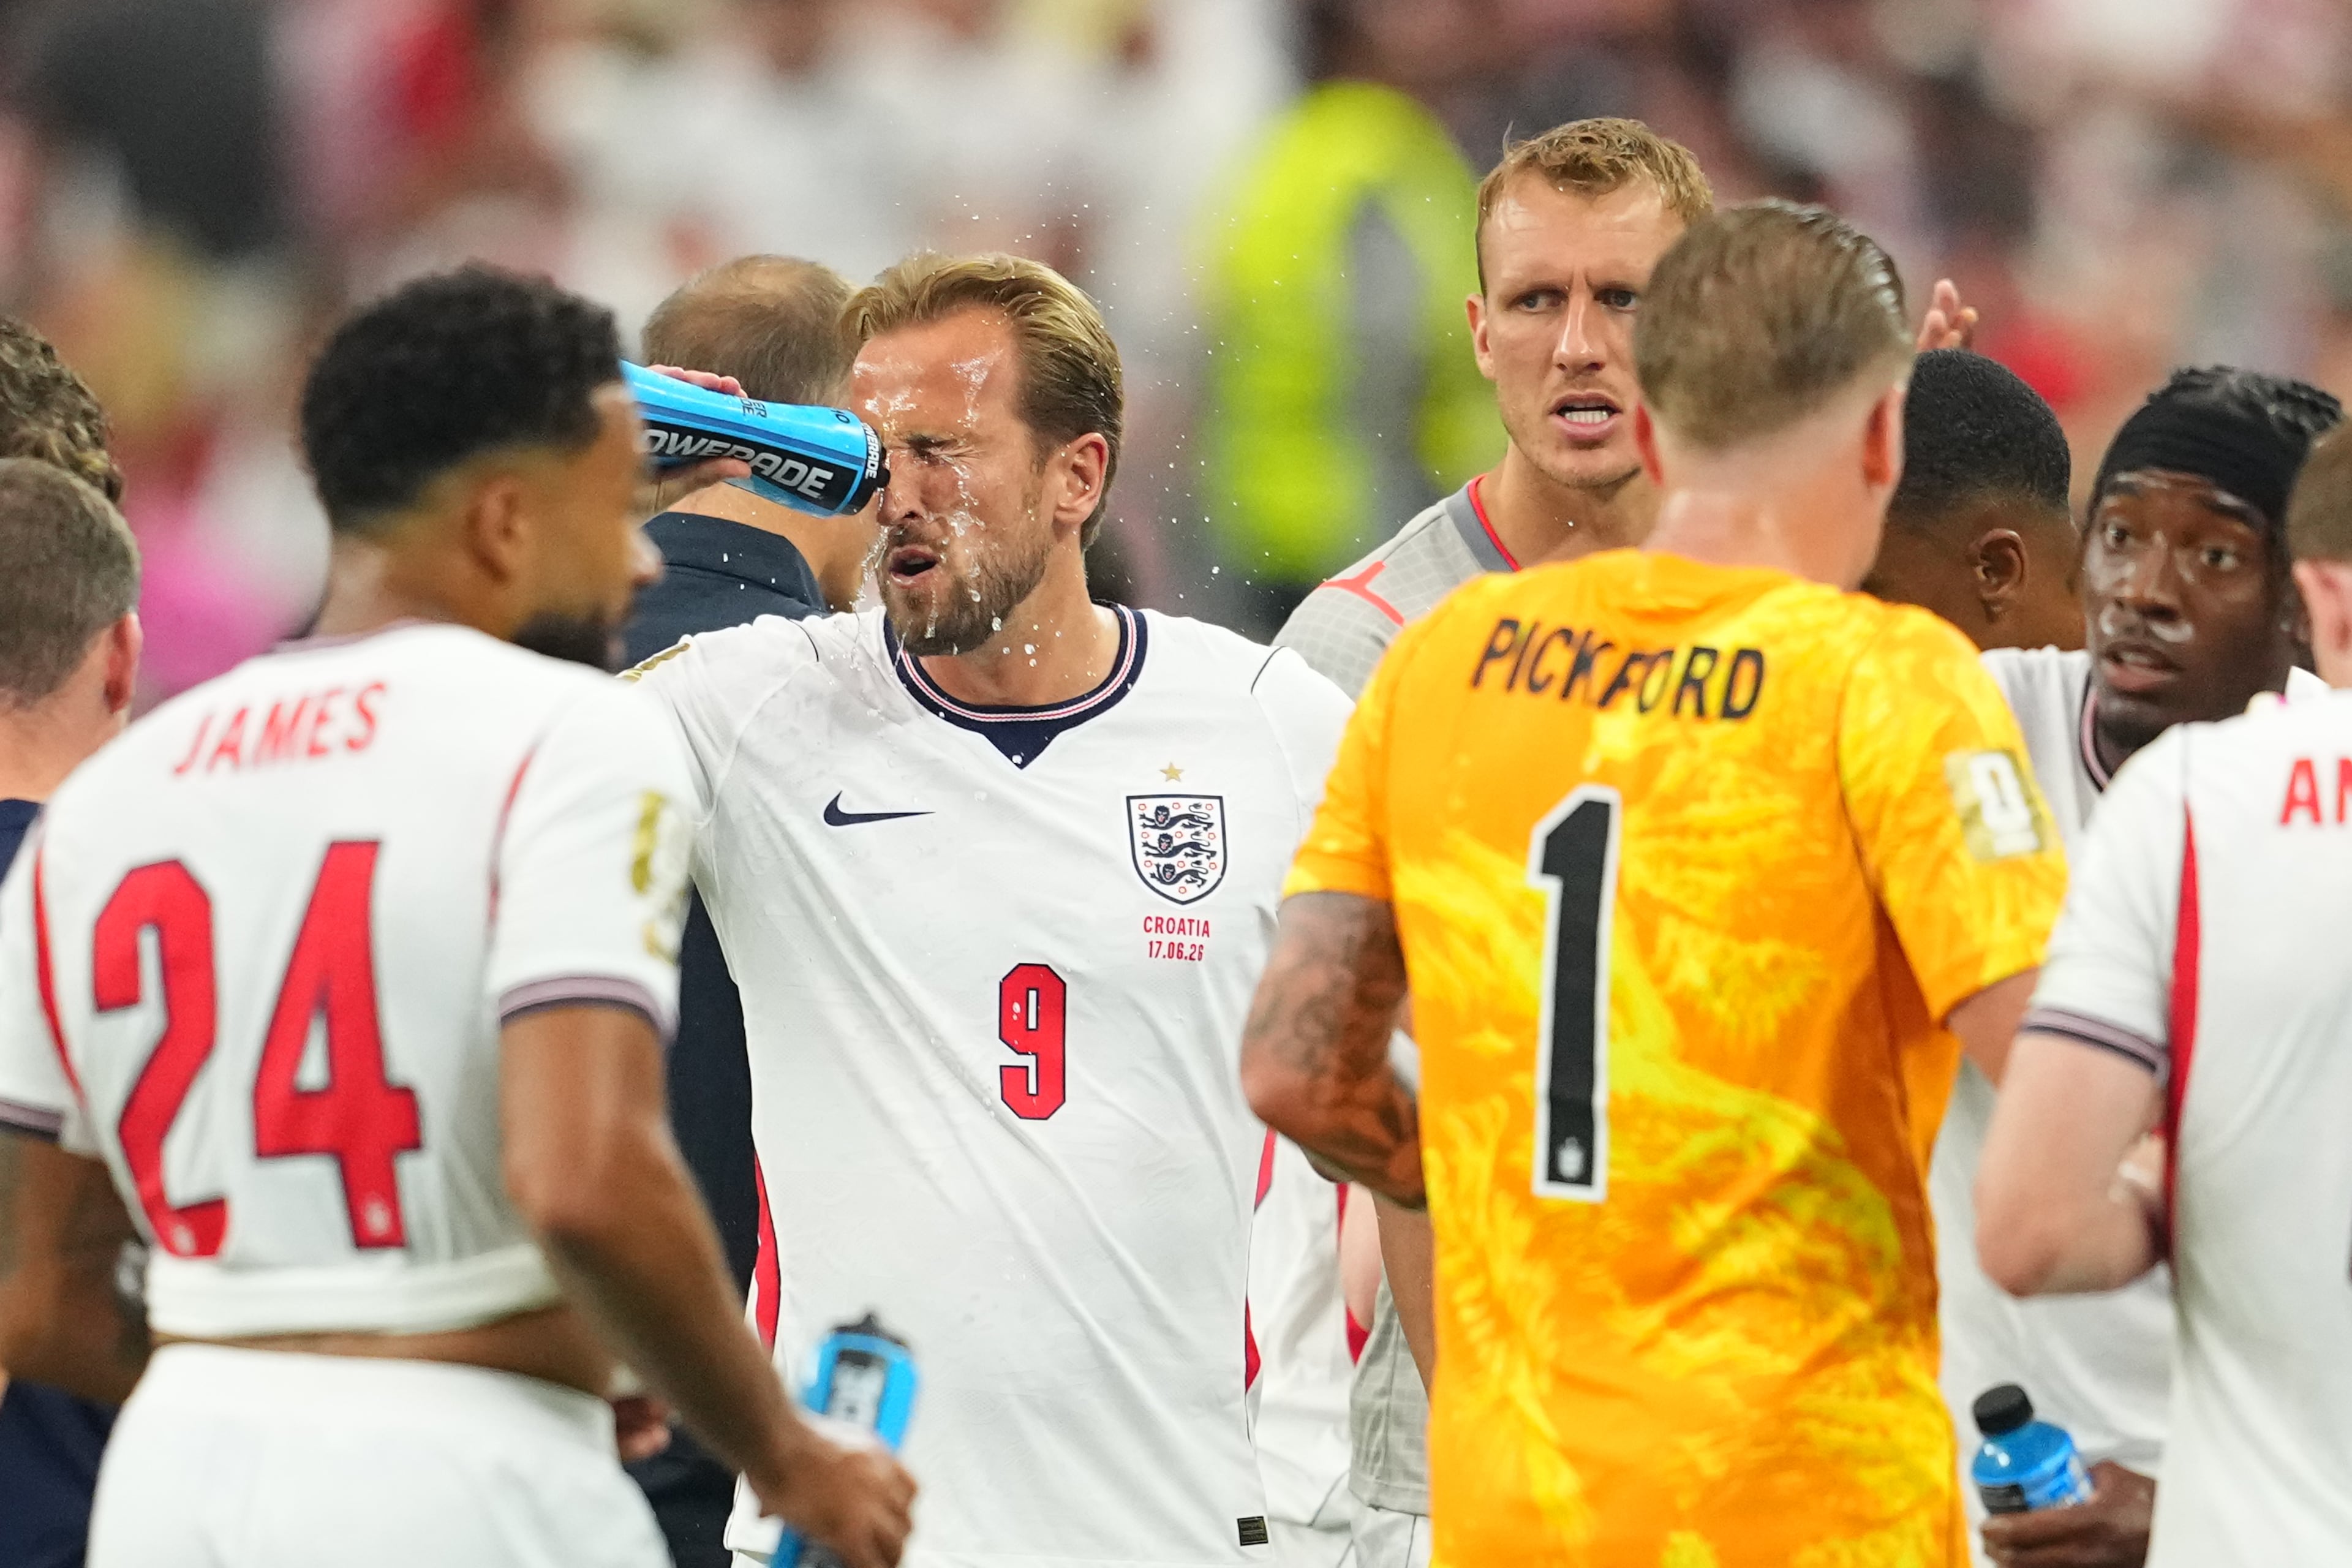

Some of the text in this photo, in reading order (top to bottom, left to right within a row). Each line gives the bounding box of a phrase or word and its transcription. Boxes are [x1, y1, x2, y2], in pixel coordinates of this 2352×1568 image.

[644, 429, 834, 499] OWERADE
[1472, 619, 1764, 720] PICKFORD
[173, 681, 388, 777] JAMES
[1143, 916, 1210, 938] CROATIA
[1148, 940, 1204, 962] 17.06.26
[998, 963, 1066, 1120] 9
[1526, 782, 1621, 1204] 1
[92, 840, 422, 1258] 24
